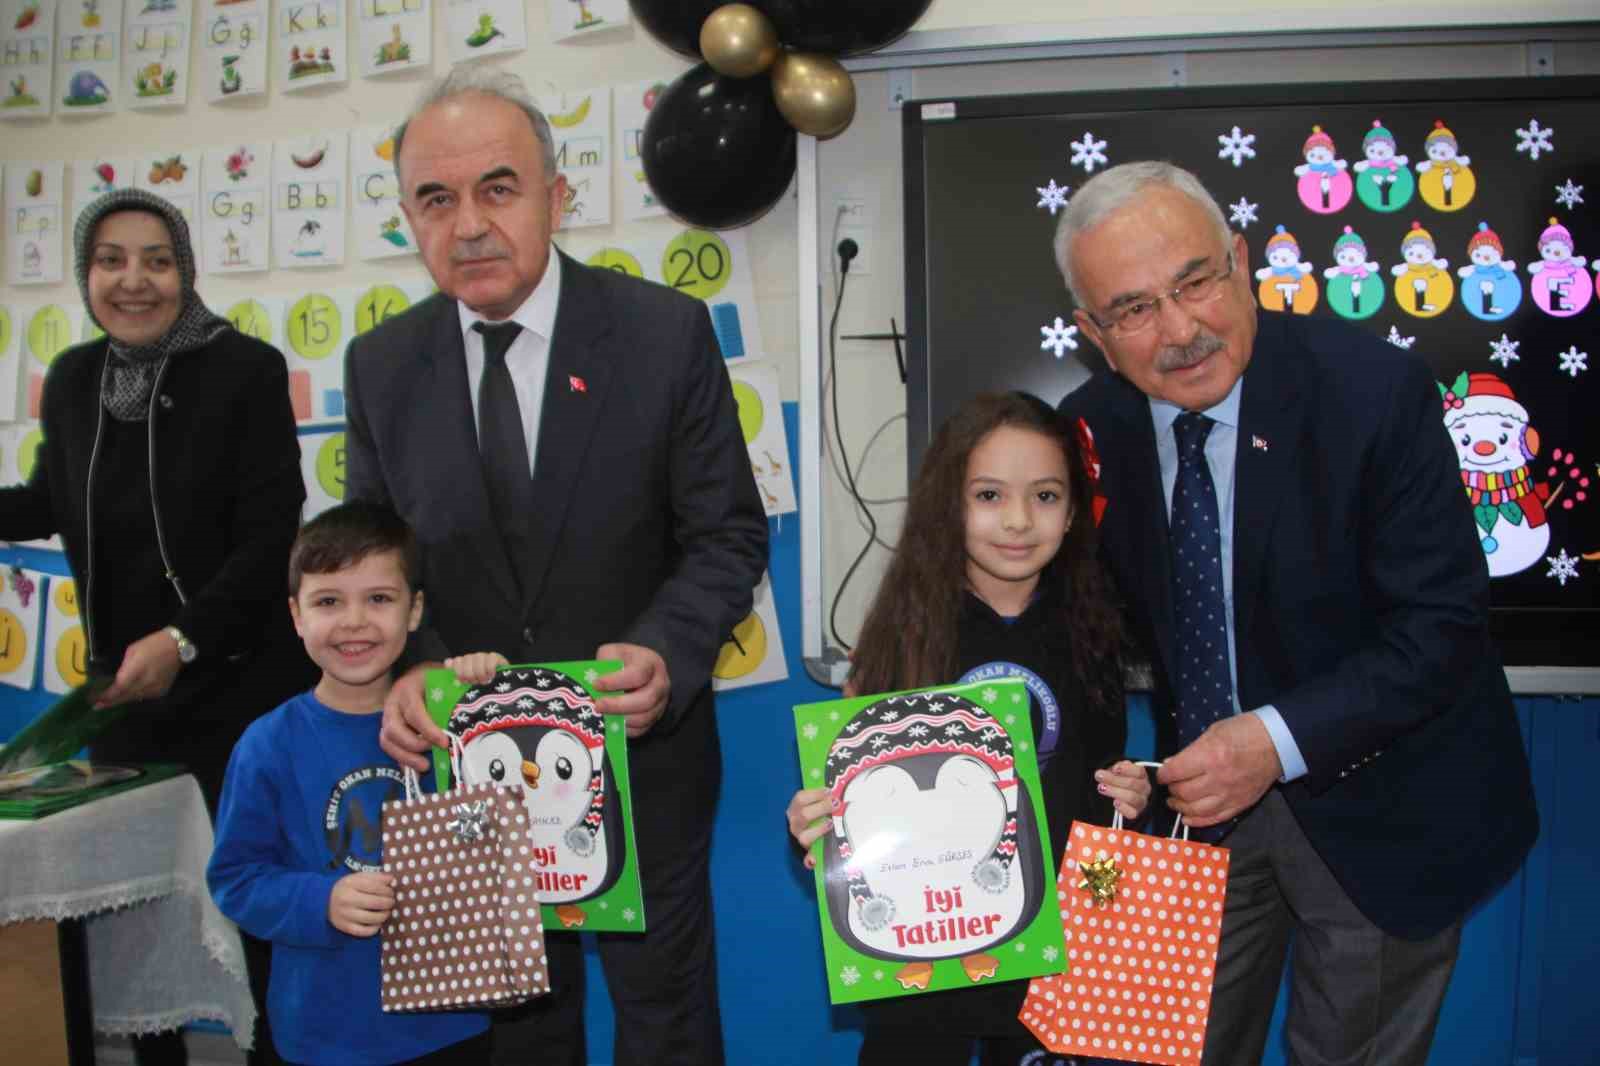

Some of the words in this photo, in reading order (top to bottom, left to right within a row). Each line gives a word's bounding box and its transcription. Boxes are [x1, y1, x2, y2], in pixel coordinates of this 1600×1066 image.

[288, 7, 303, 32] K
[579, 151, 598, 166] m
[287, 183, 300, 210] B
[315, 183, 328, 208] b
[669, 242, 724, 288] 20
[299, 306, 330, 347] 15
[532, 845, 557, 867] yi
[535, 871, 588, 892] iller
[923, 884, 963, 913] İyi
[891, 913, 1001, 948] Tatiller
